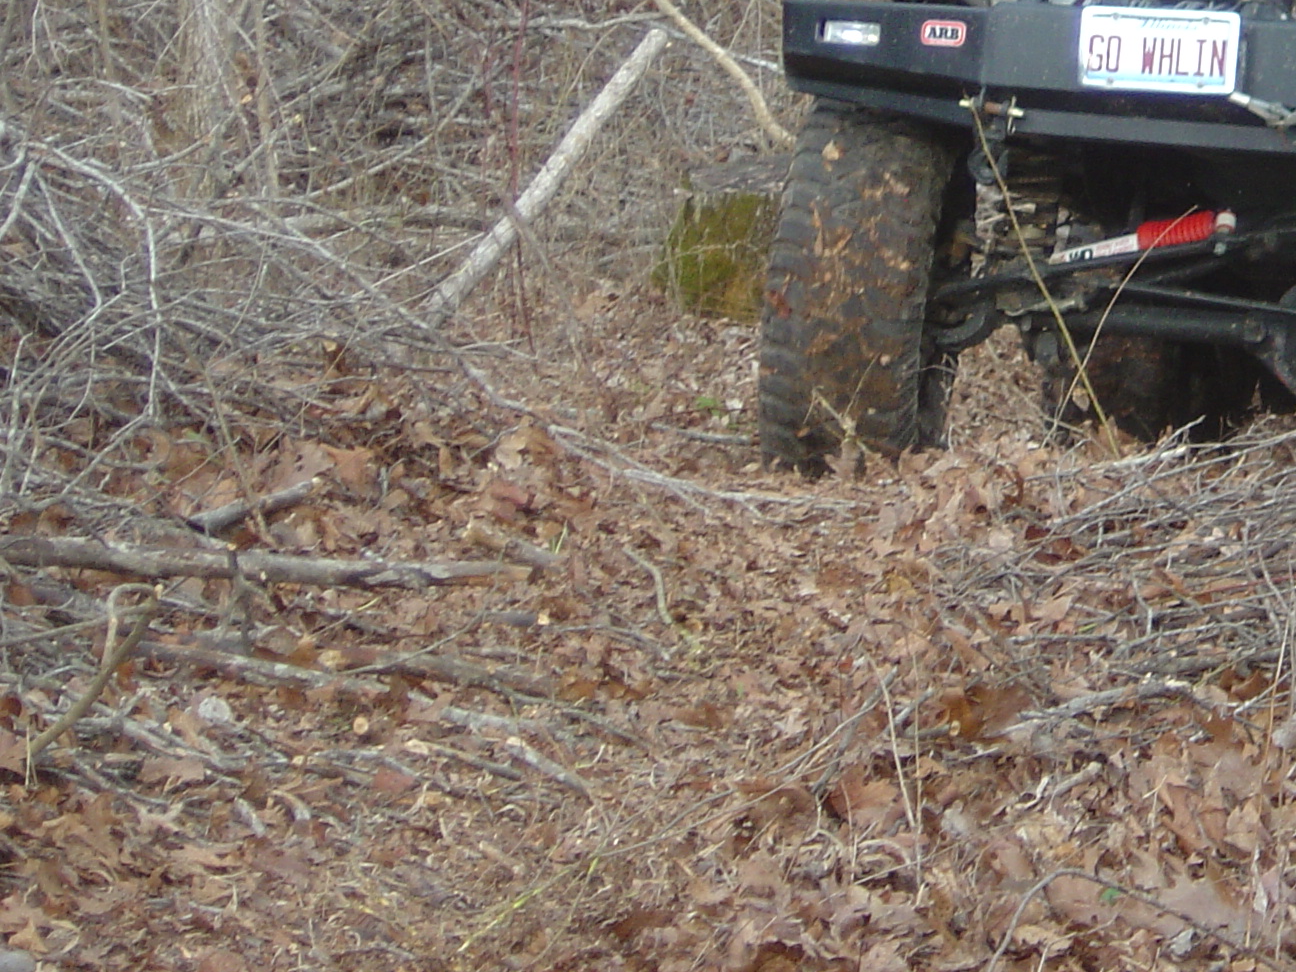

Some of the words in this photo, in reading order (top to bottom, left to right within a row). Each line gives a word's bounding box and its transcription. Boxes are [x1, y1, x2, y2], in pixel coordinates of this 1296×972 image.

[927, 27, 960, 40] ARB
[1087, 34, 1122, 73] GO
[1140, 37, 1228, 77] WHLIN
